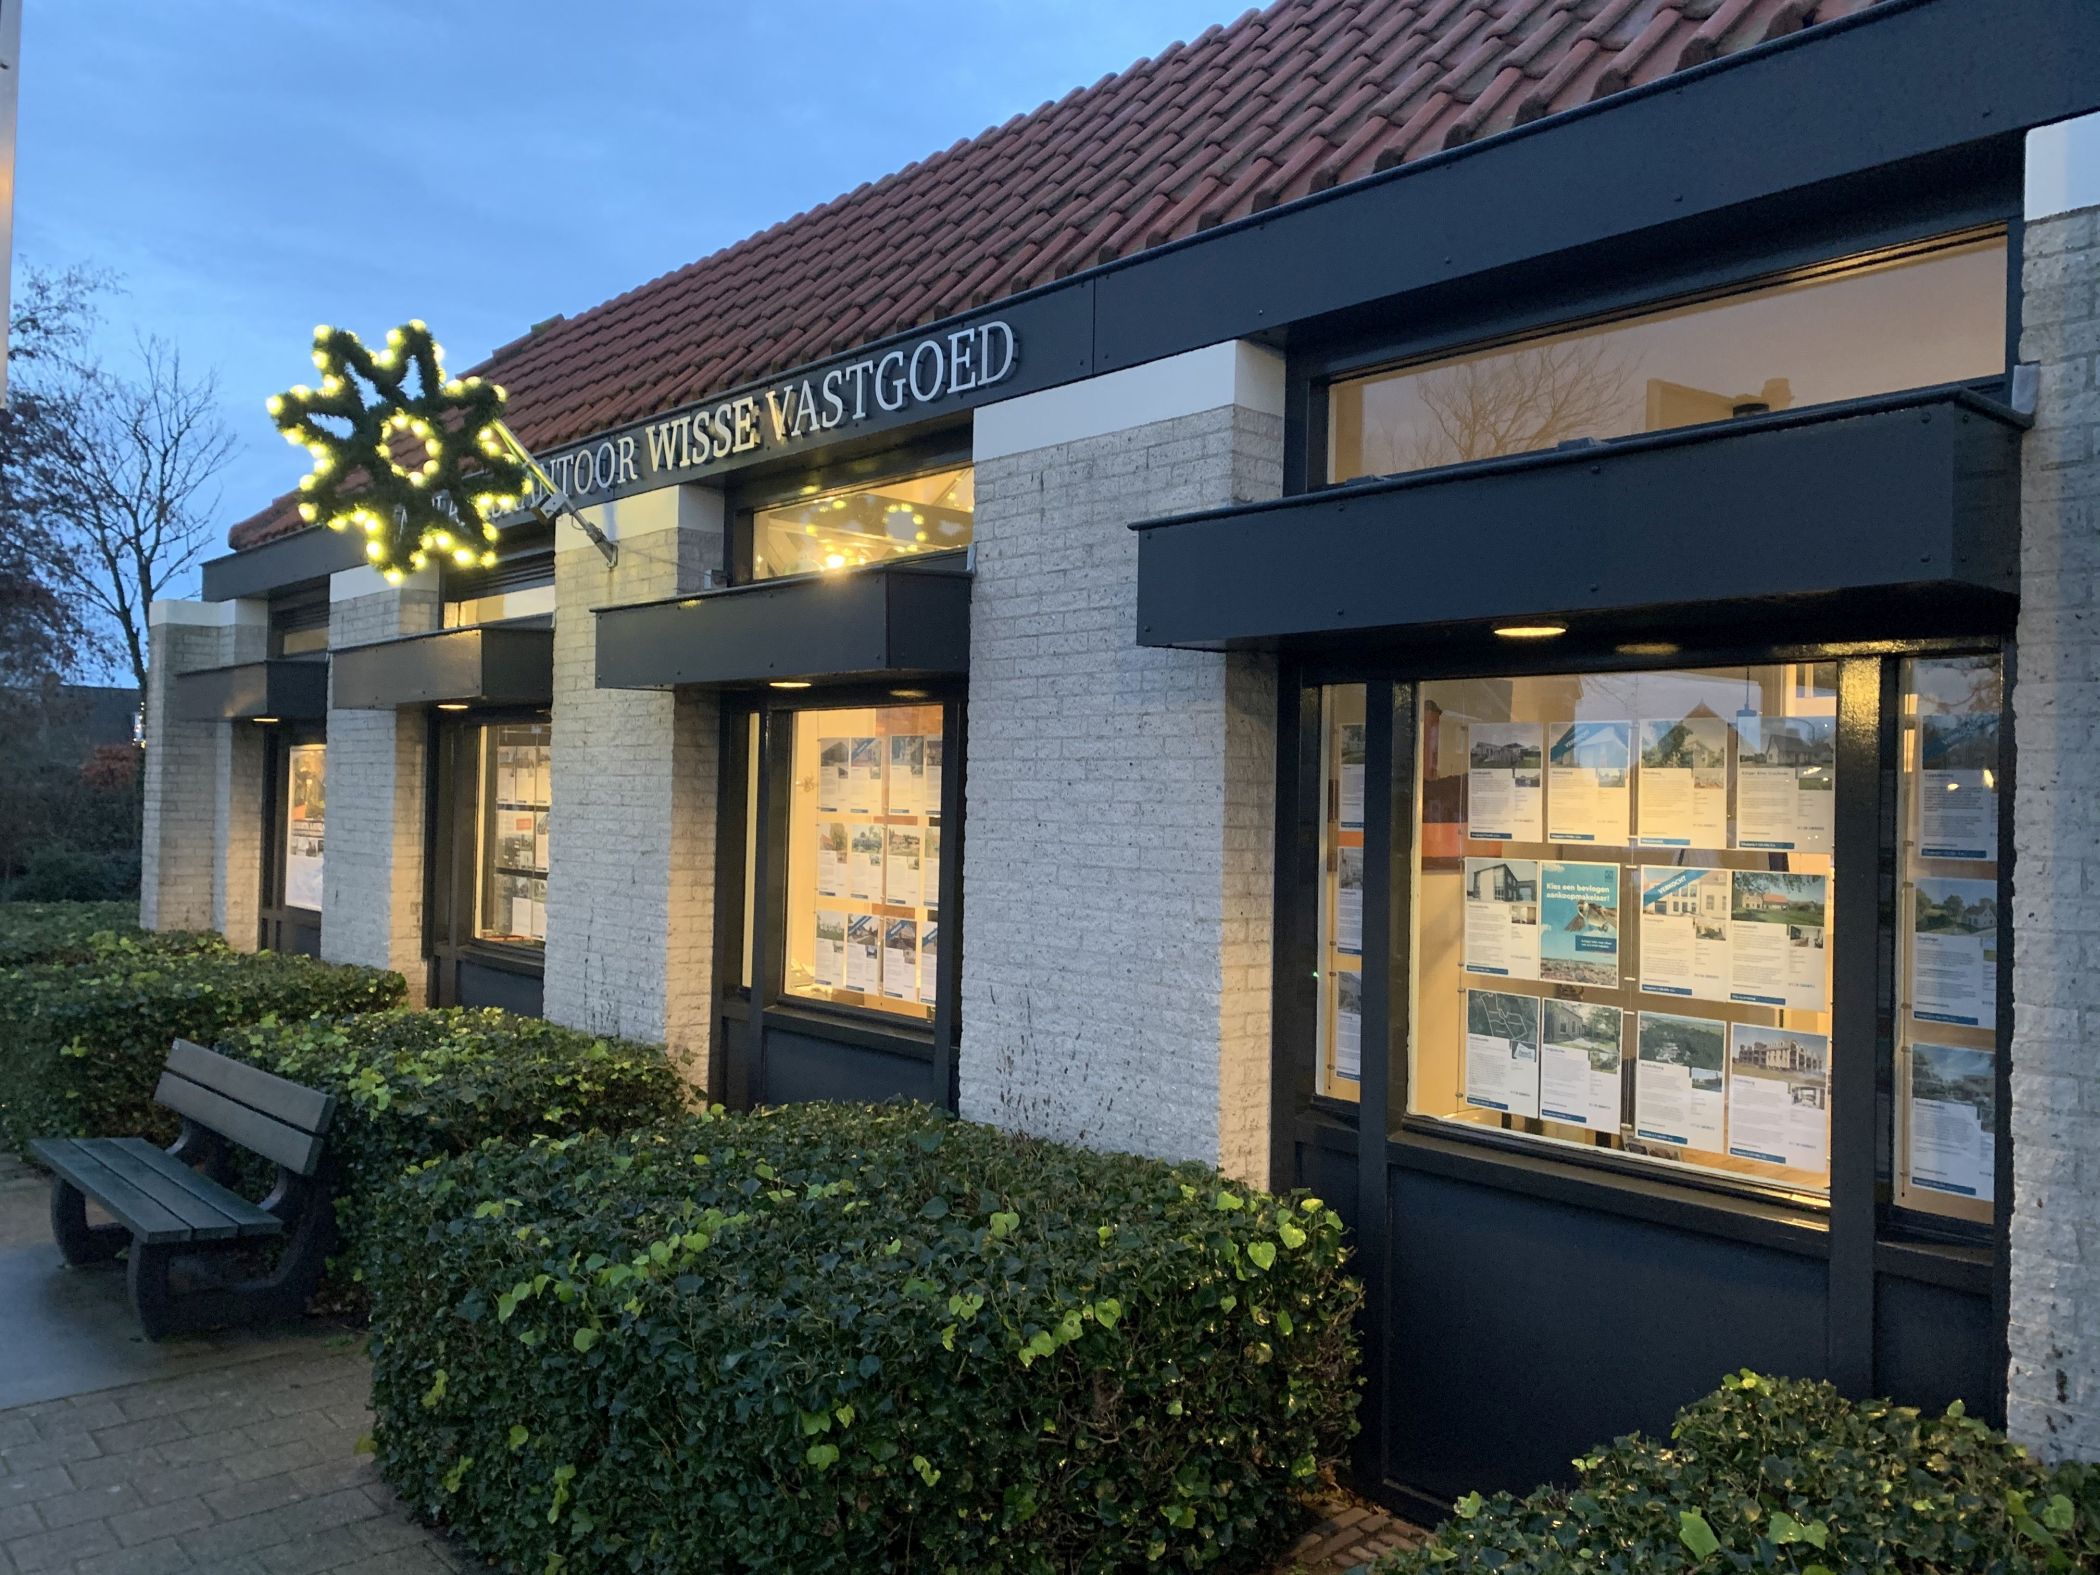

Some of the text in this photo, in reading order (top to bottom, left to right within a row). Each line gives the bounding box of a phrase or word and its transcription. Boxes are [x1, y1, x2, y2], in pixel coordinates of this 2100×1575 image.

[645, 396, 756, 473] WISSE
[764, 320, 1016, 440] VASTGOED
[1576, 883, 1610, 894] bevlogen
